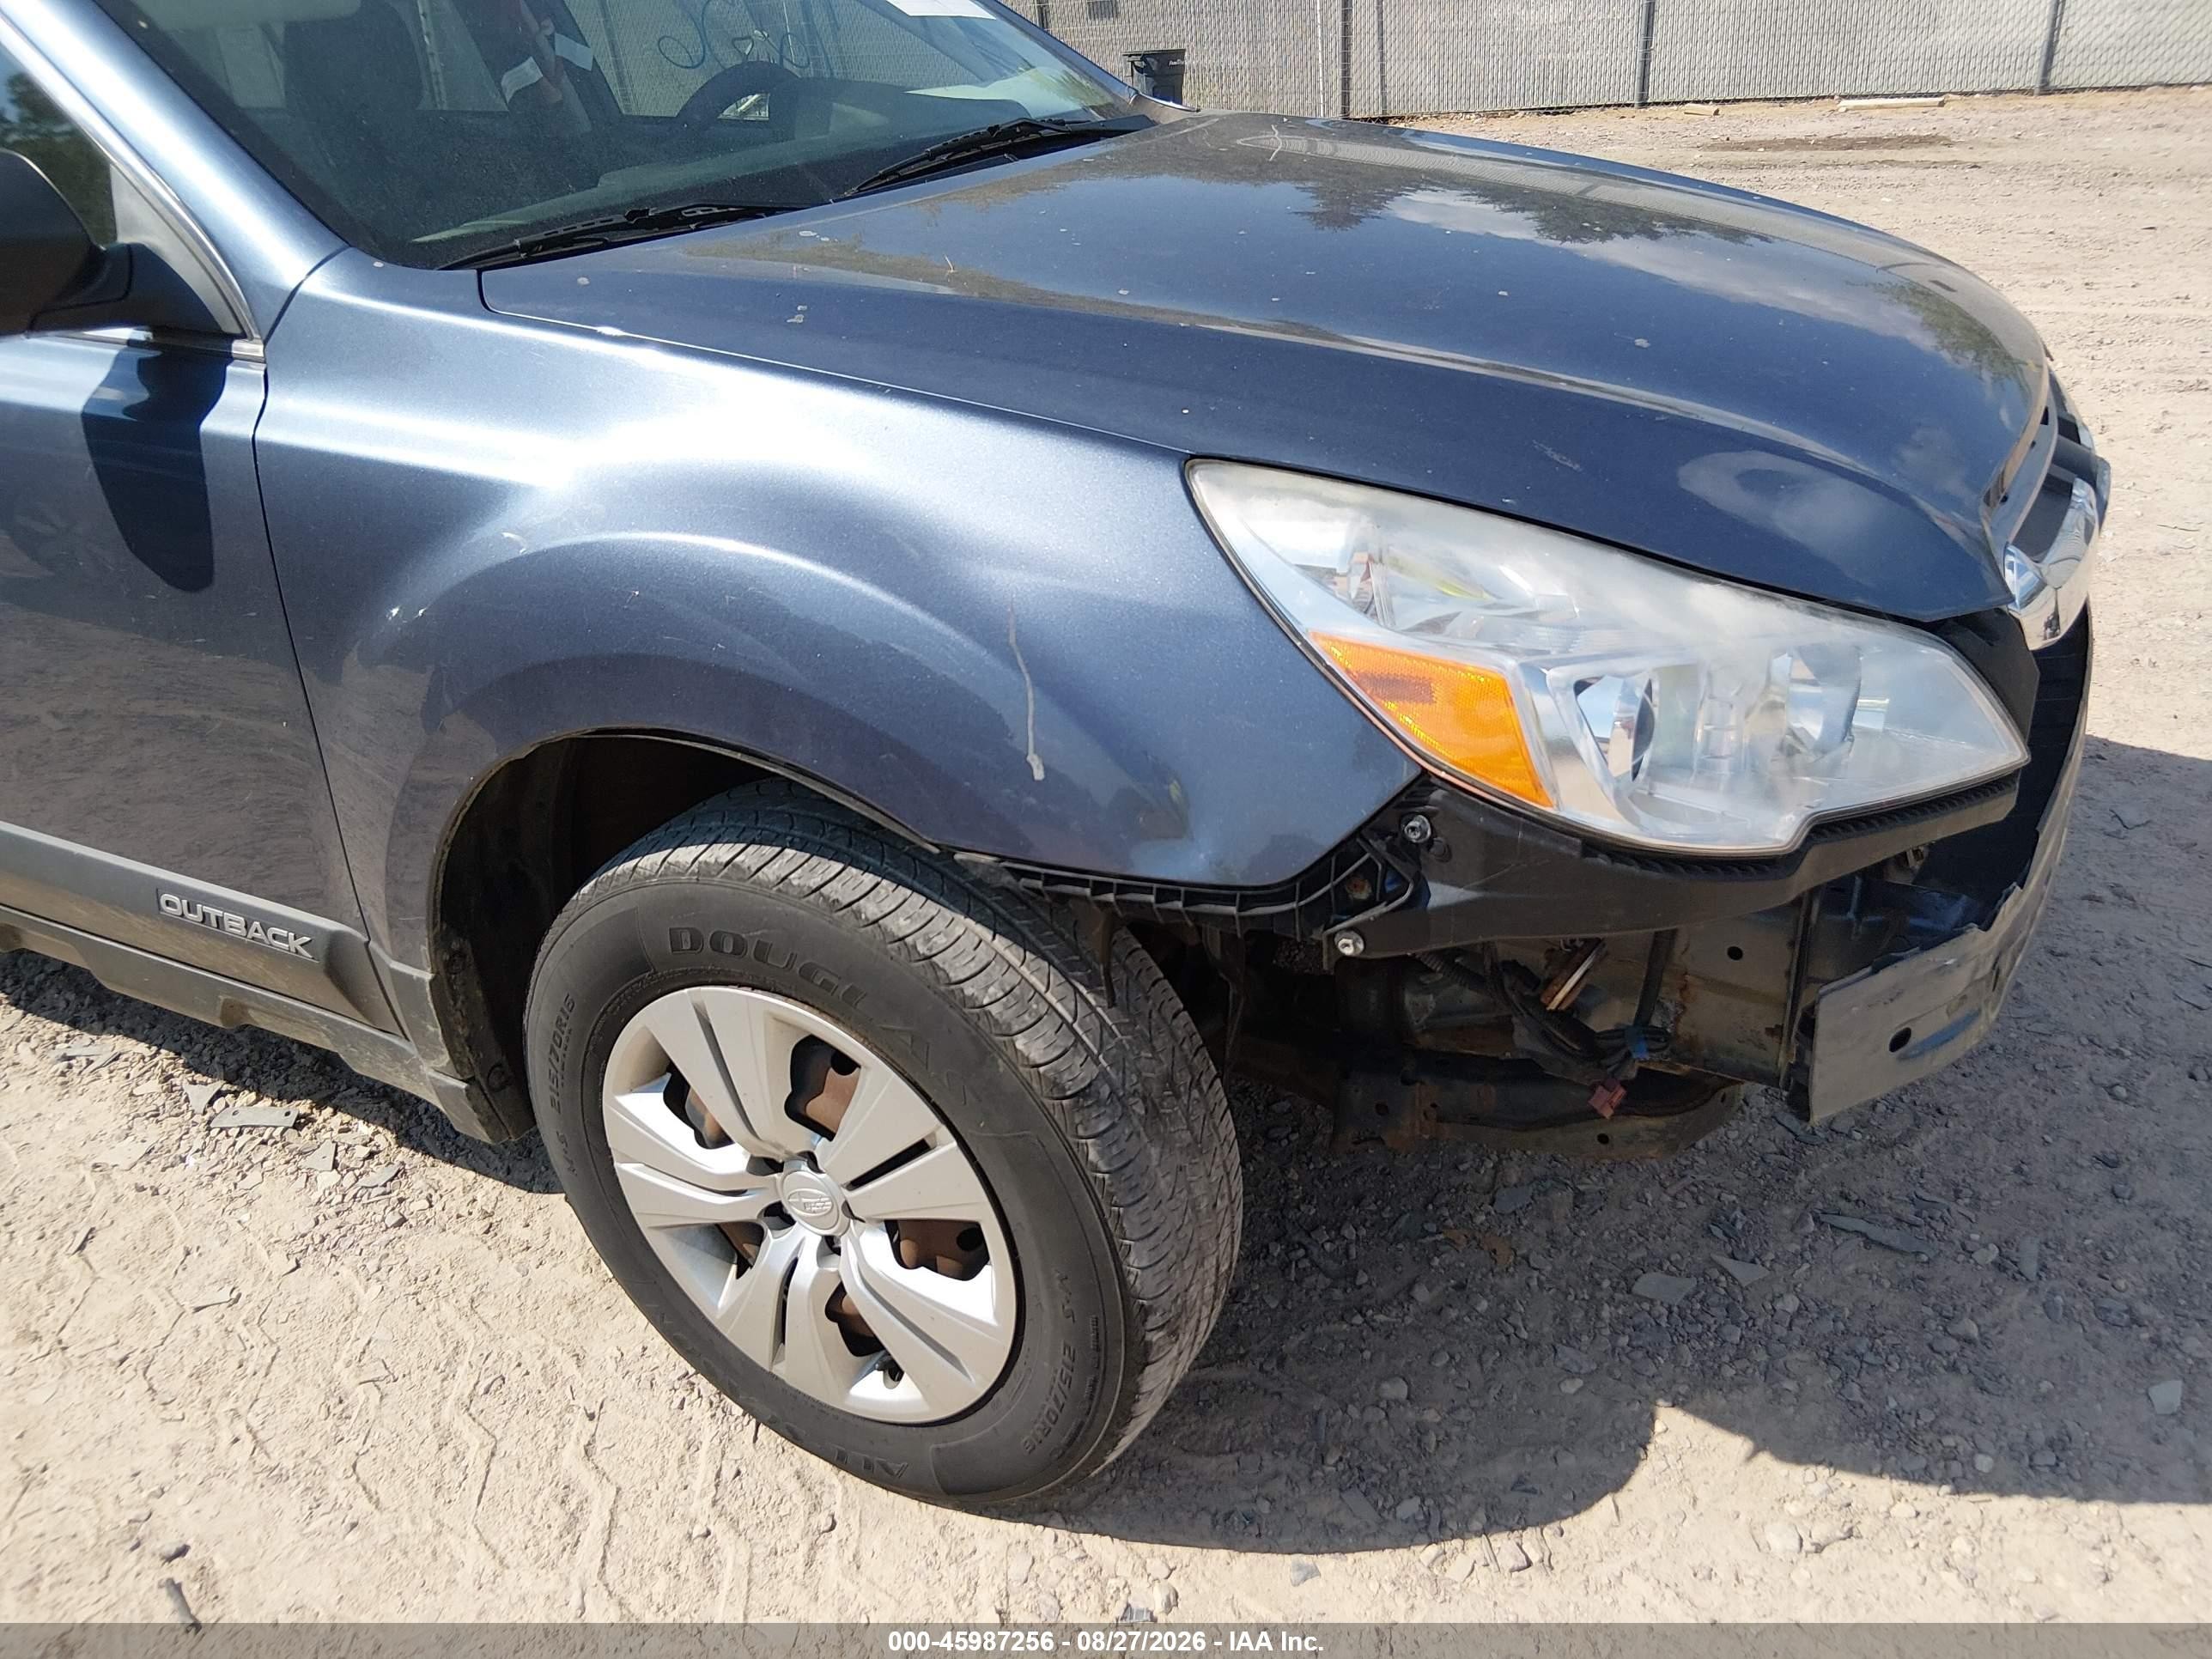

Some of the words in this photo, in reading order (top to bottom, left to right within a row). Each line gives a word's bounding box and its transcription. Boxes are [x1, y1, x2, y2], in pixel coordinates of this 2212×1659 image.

[160, 893, 314, 959] OUTBACK
[547, 992, 576, 1115] 215/70R16
[1022, 1340, 1075, 1455] 215/70R16
